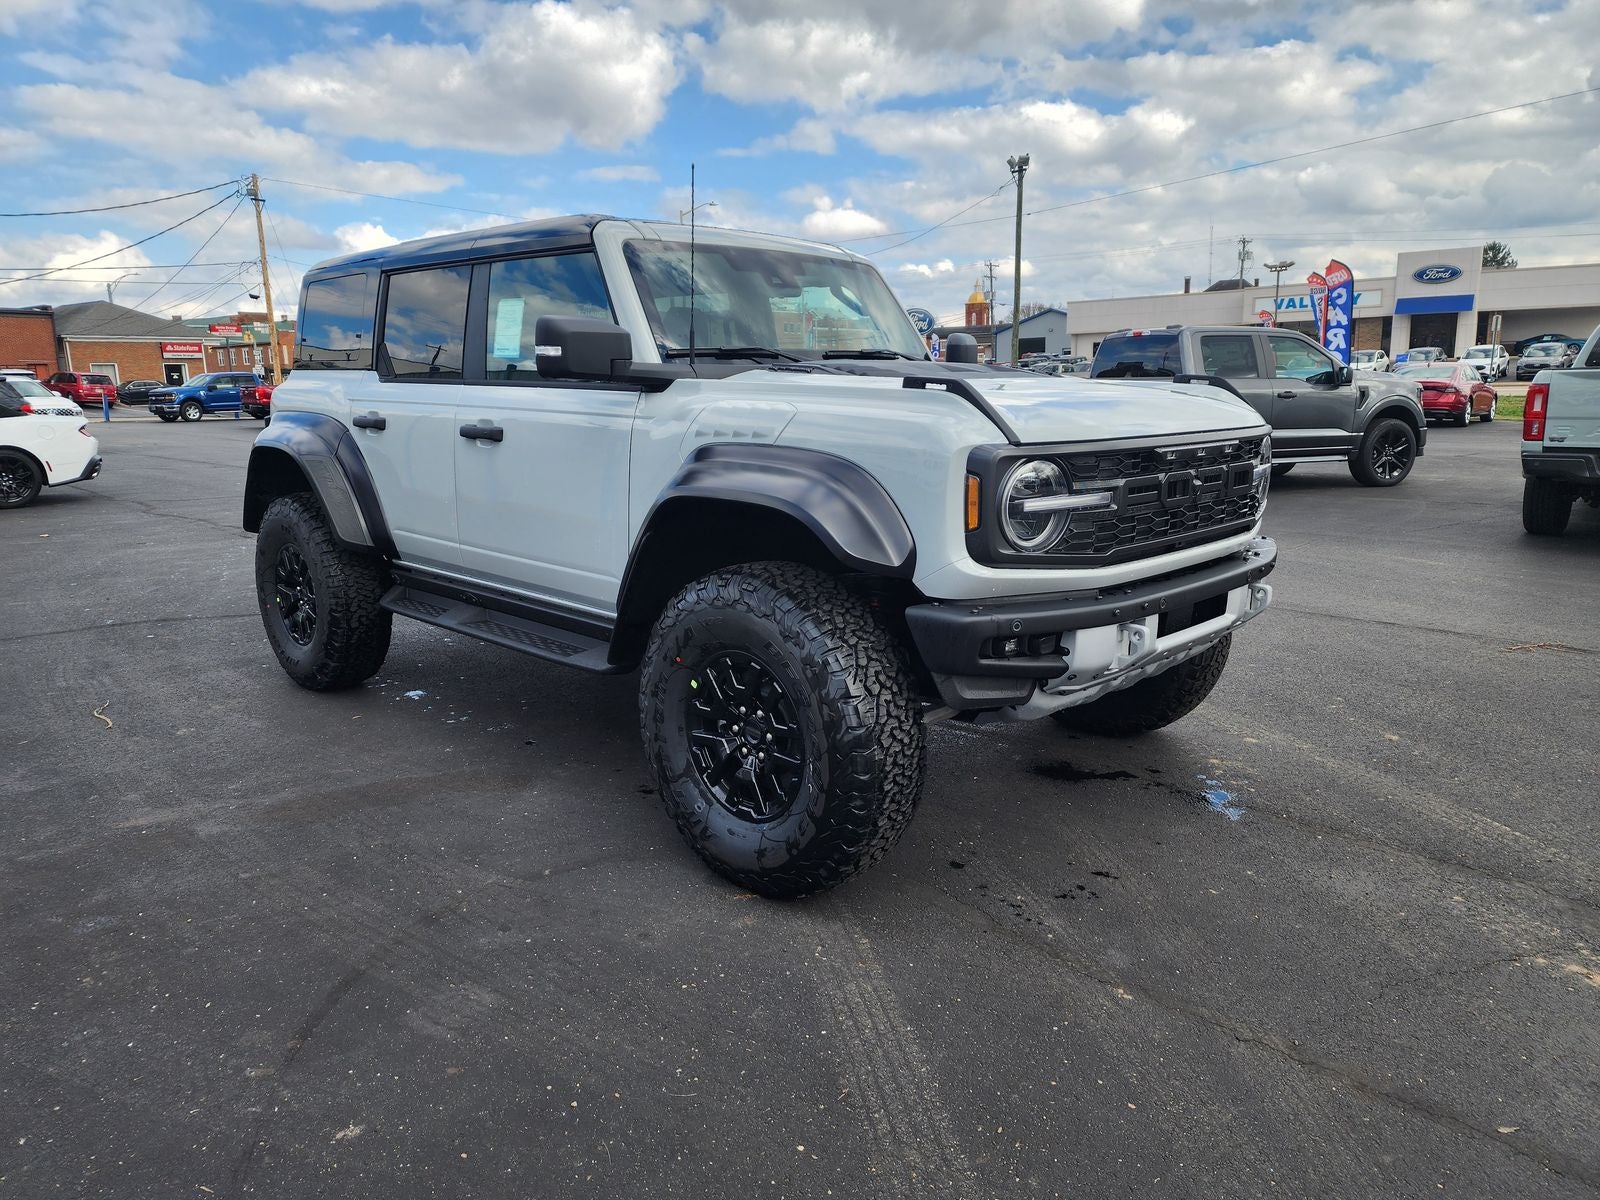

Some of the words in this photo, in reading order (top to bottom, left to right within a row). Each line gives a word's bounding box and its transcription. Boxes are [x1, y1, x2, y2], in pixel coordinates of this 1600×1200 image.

[1423, 267, 1452, 280] Ford
[1274, 293, 1362, 310] VALY
[1120, 461, 1254, 515] FORD
